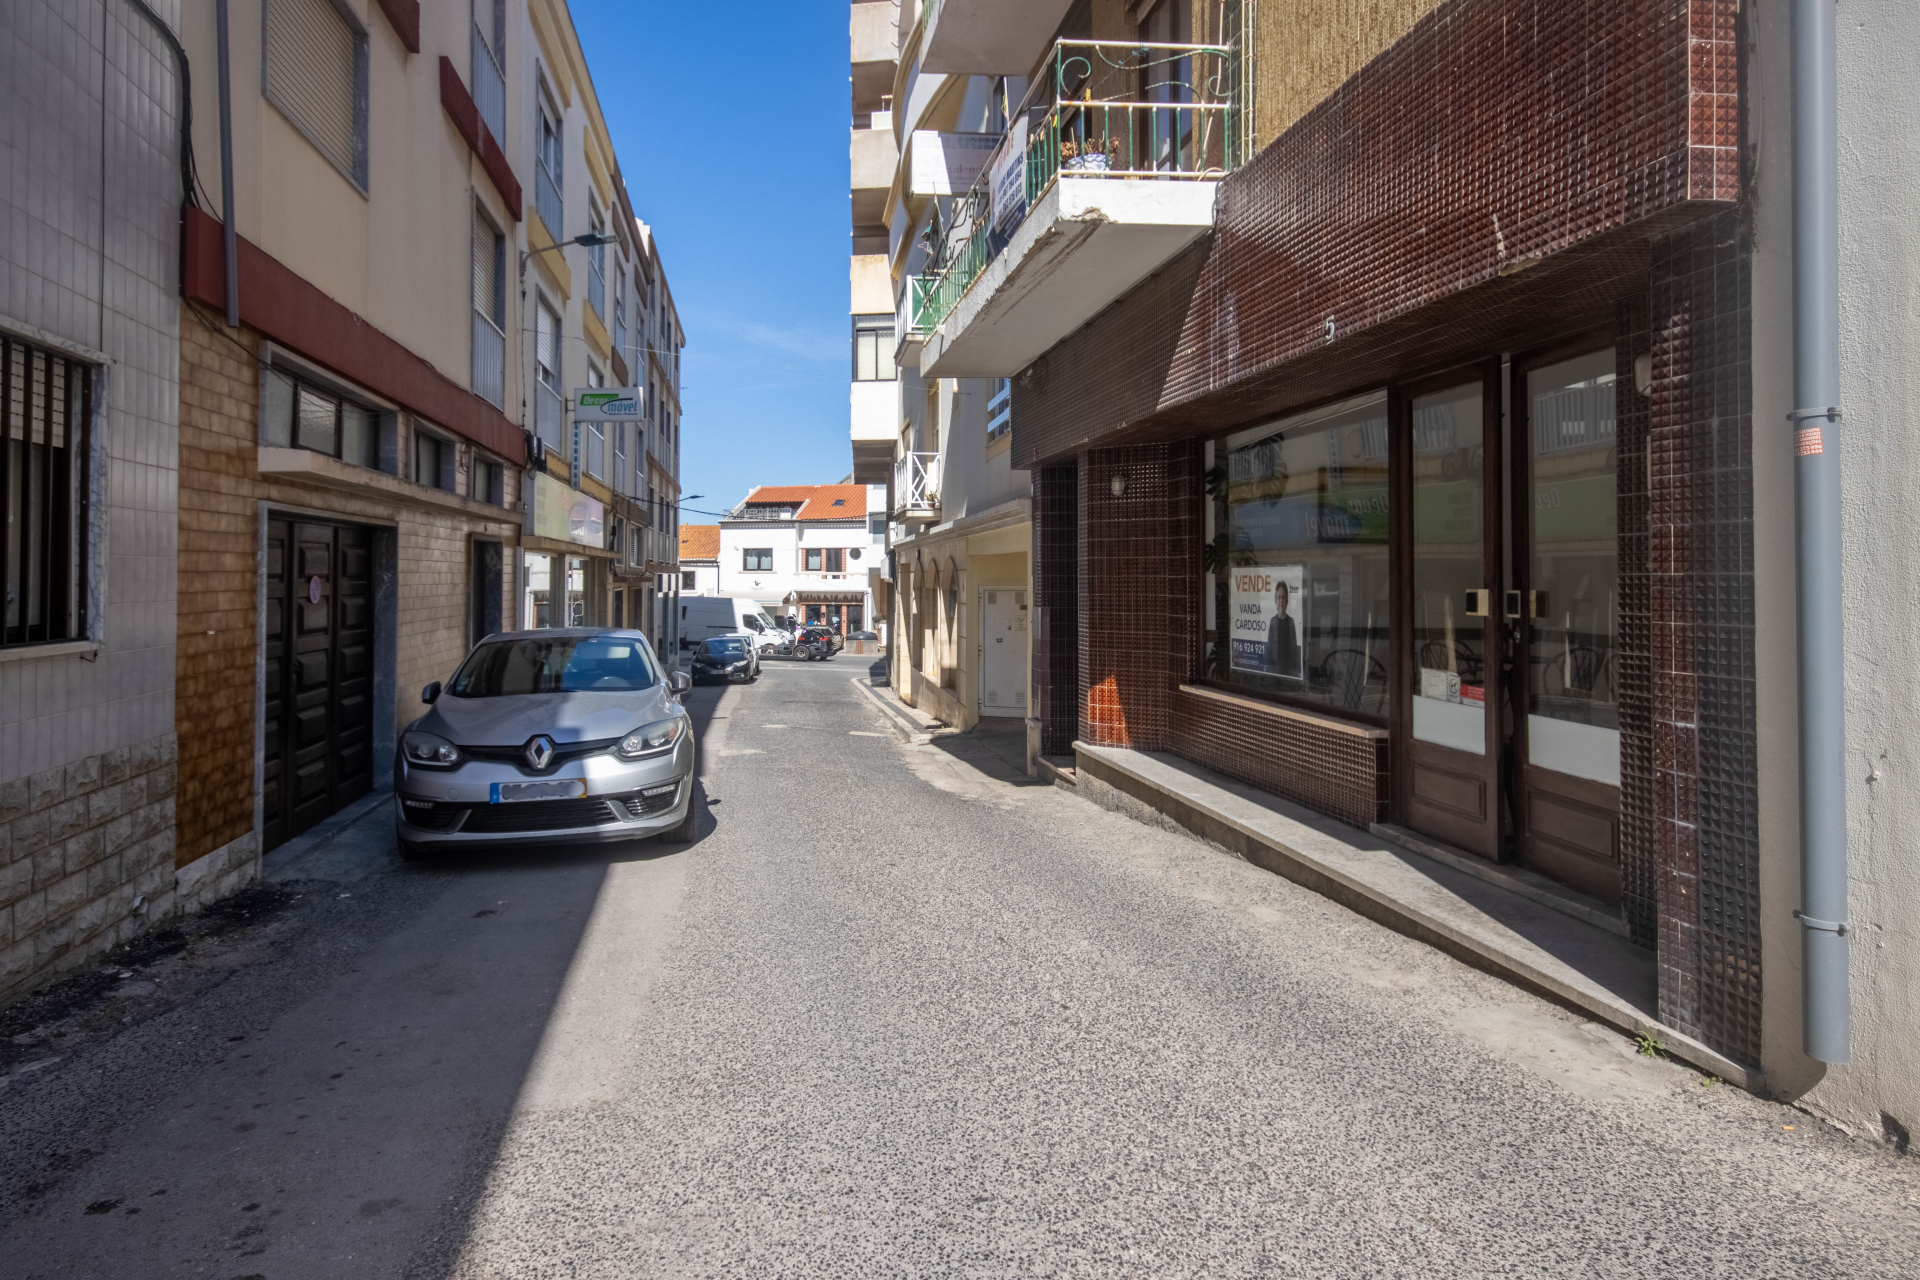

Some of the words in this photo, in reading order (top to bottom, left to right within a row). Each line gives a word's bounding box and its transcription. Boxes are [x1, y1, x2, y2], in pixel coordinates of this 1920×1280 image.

[1325, 314, 1335, 340] 5
[583, 396, 608, 405] Decor
[607, 400, 638, 412] móvel
[1235, 574, 1272, 593] VENDE
[1239, 603, 1262, 615] VANDA
[1235, 618, 1267, 632] CARDOSO
[1233, 641, 1243, 652] 916
[1244, 643, 1254, 653] 924
[1255, 645, 1265, 655] 921
